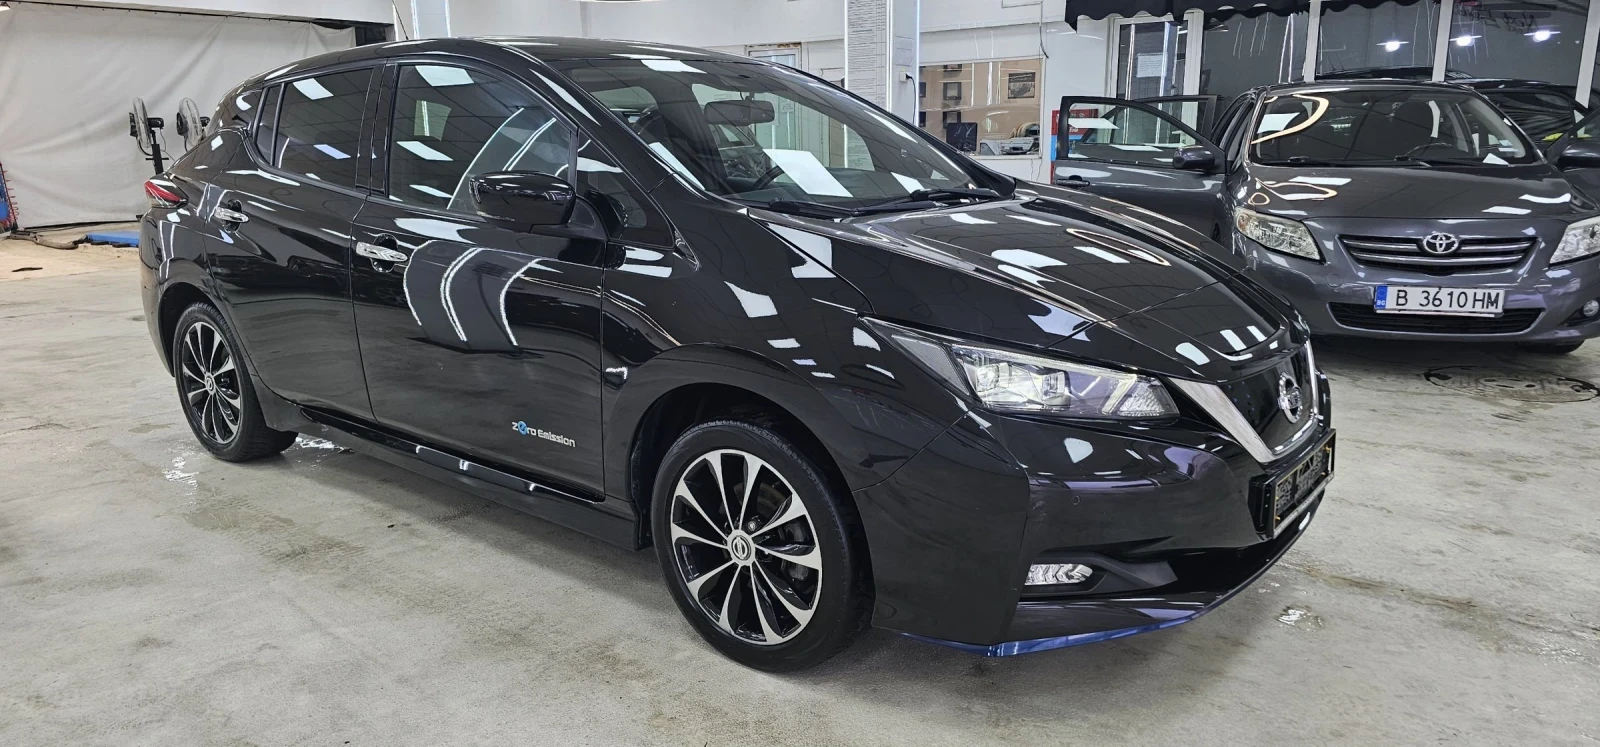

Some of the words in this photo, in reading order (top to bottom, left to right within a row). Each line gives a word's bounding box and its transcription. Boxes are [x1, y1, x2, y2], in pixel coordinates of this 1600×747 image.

[1395, 289, 1408, 307] B
[1419, 290, 1468, 308] 3610
[1472, 292, 1500, 309] HM
[537, 429, 576, 448] Emission
